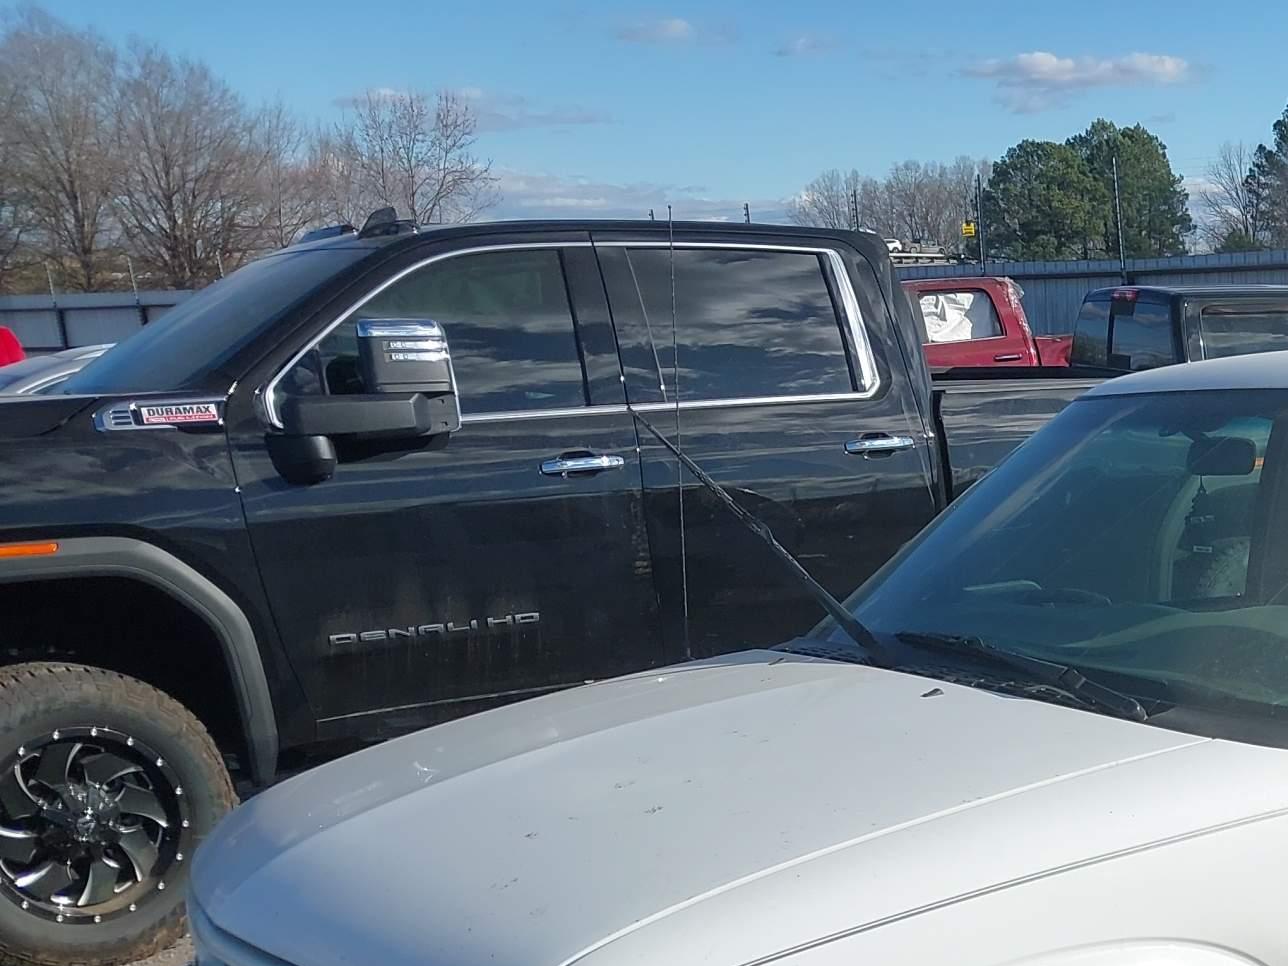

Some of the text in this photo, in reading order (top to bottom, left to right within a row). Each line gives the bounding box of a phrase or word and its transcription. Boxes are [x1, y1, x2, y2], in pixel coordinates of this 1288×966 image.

[146, 405, 212, 417] DURAMAX
[329, 612, 540, 645] DENALI HD
